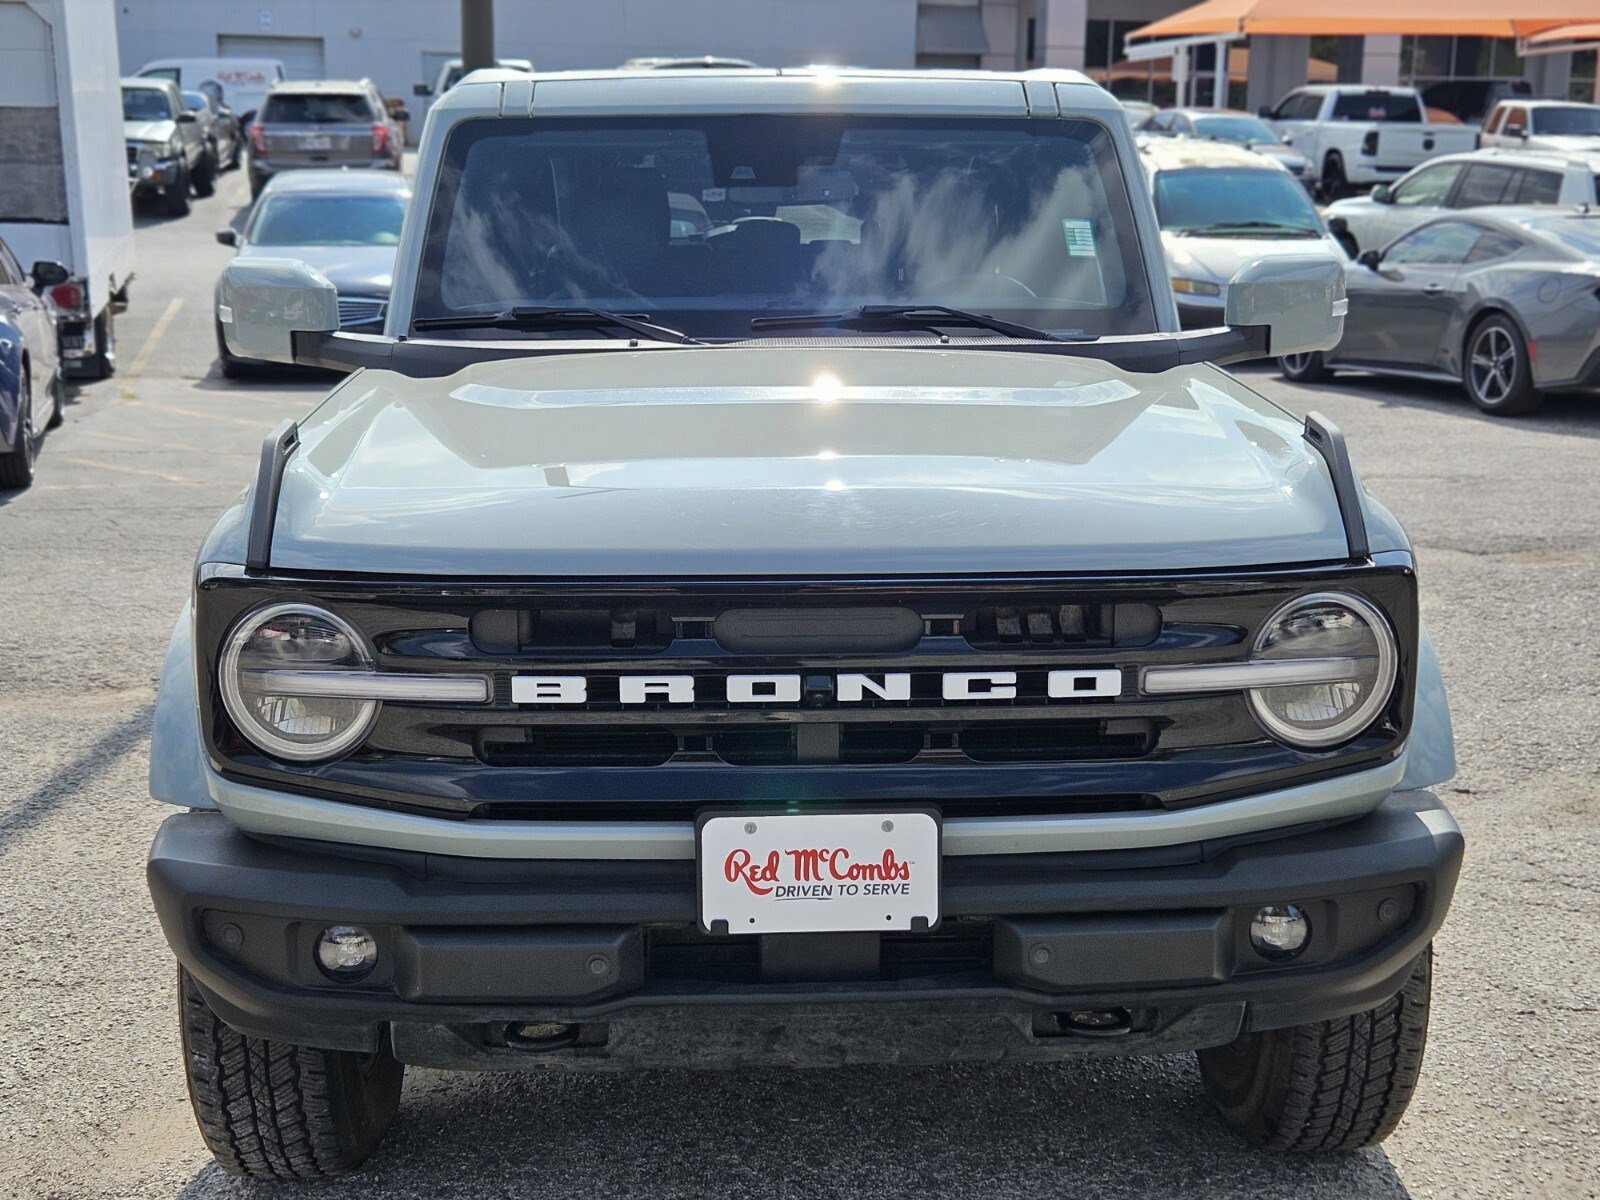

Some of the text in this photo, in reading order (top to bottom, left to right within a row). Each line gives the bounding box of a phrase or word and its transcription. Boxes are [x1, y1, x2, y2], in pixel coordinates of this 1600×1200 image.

[511, 669, 1122, 704] BRONCO
[724, 847, 911, 896] Red McCombs
[775, 883, 910, 898] DRIVEN TO SERVE
